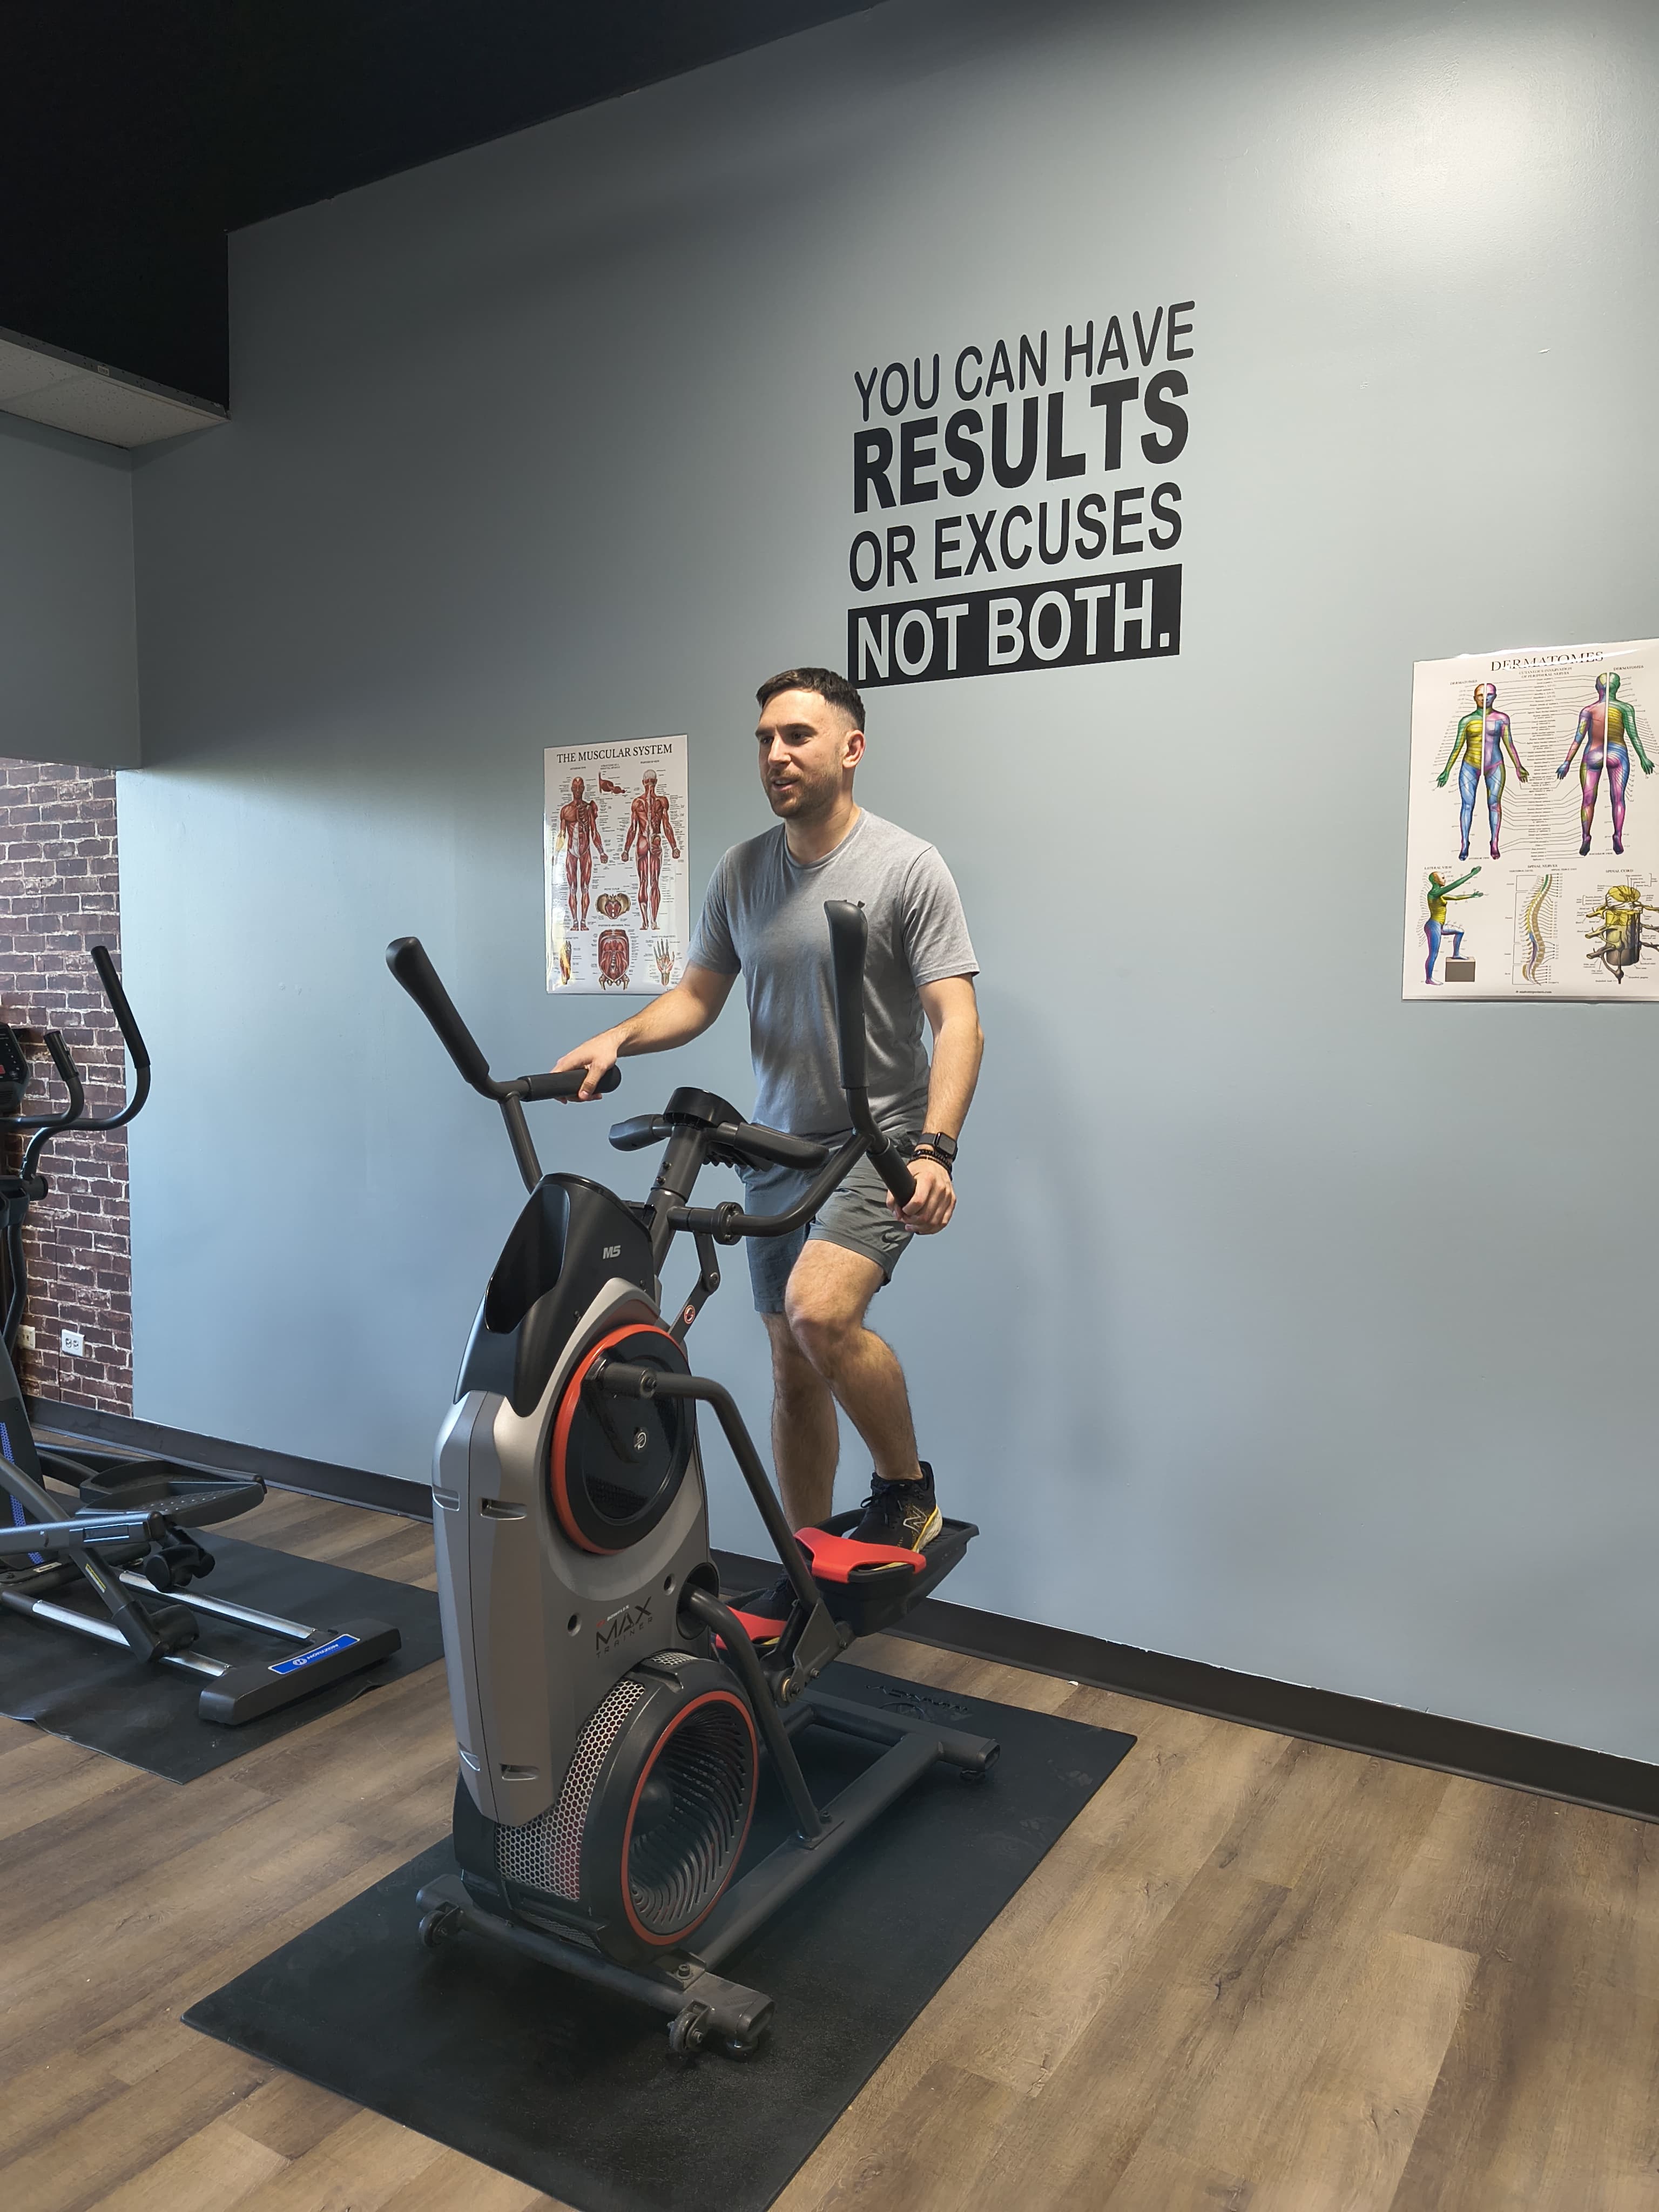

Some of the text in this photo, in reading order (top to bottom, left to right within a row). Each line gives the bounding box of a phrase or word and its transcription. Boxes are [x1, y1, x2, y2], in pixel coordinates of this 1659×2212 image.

[854, 301, 1195, 422] YOU CAN HAVE
[854, 369, 1189, 514] RESULTS
[849, 482, 1182, 592] OR EXCUSES
[858, 578, 1170, 681] NOT BOTH.
[1491, 651, 1603, 671] DERMATOMES
[557, 744, 673, 764] THE MUSCULAR SYSTEM
[602, 1245, 621, 1259] M5
[596, 1596, 652, 1651] MAX
[596, 1616, 653, 1659] TRAINER
[306, 1643, 339, 1660] HORIZON
